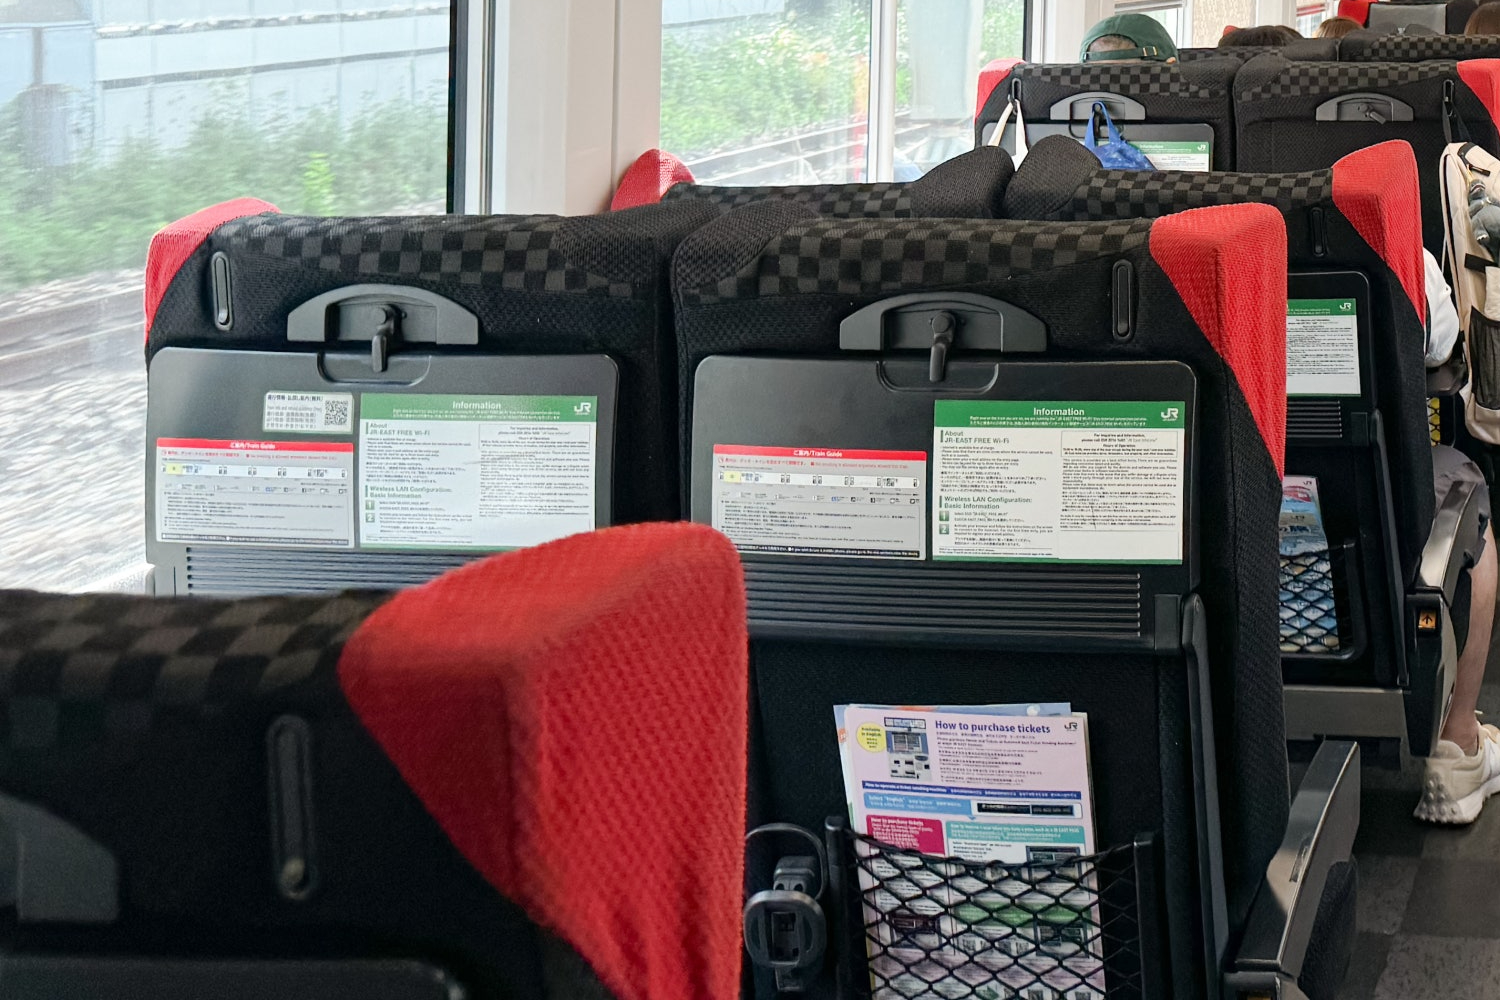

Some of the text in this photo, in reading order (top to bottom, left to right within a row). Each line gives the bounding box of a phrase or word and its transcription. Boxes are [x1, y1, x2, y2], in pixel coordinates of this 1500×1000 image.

[452, 401, 591, 413] Information JR
[1034, 407, 1179, 419] Information JR
[368, 514, 373, 522] 2
[935, 721, 1051, 734] How to purchase tickets
[1064, 722, 1078, 730] JR
